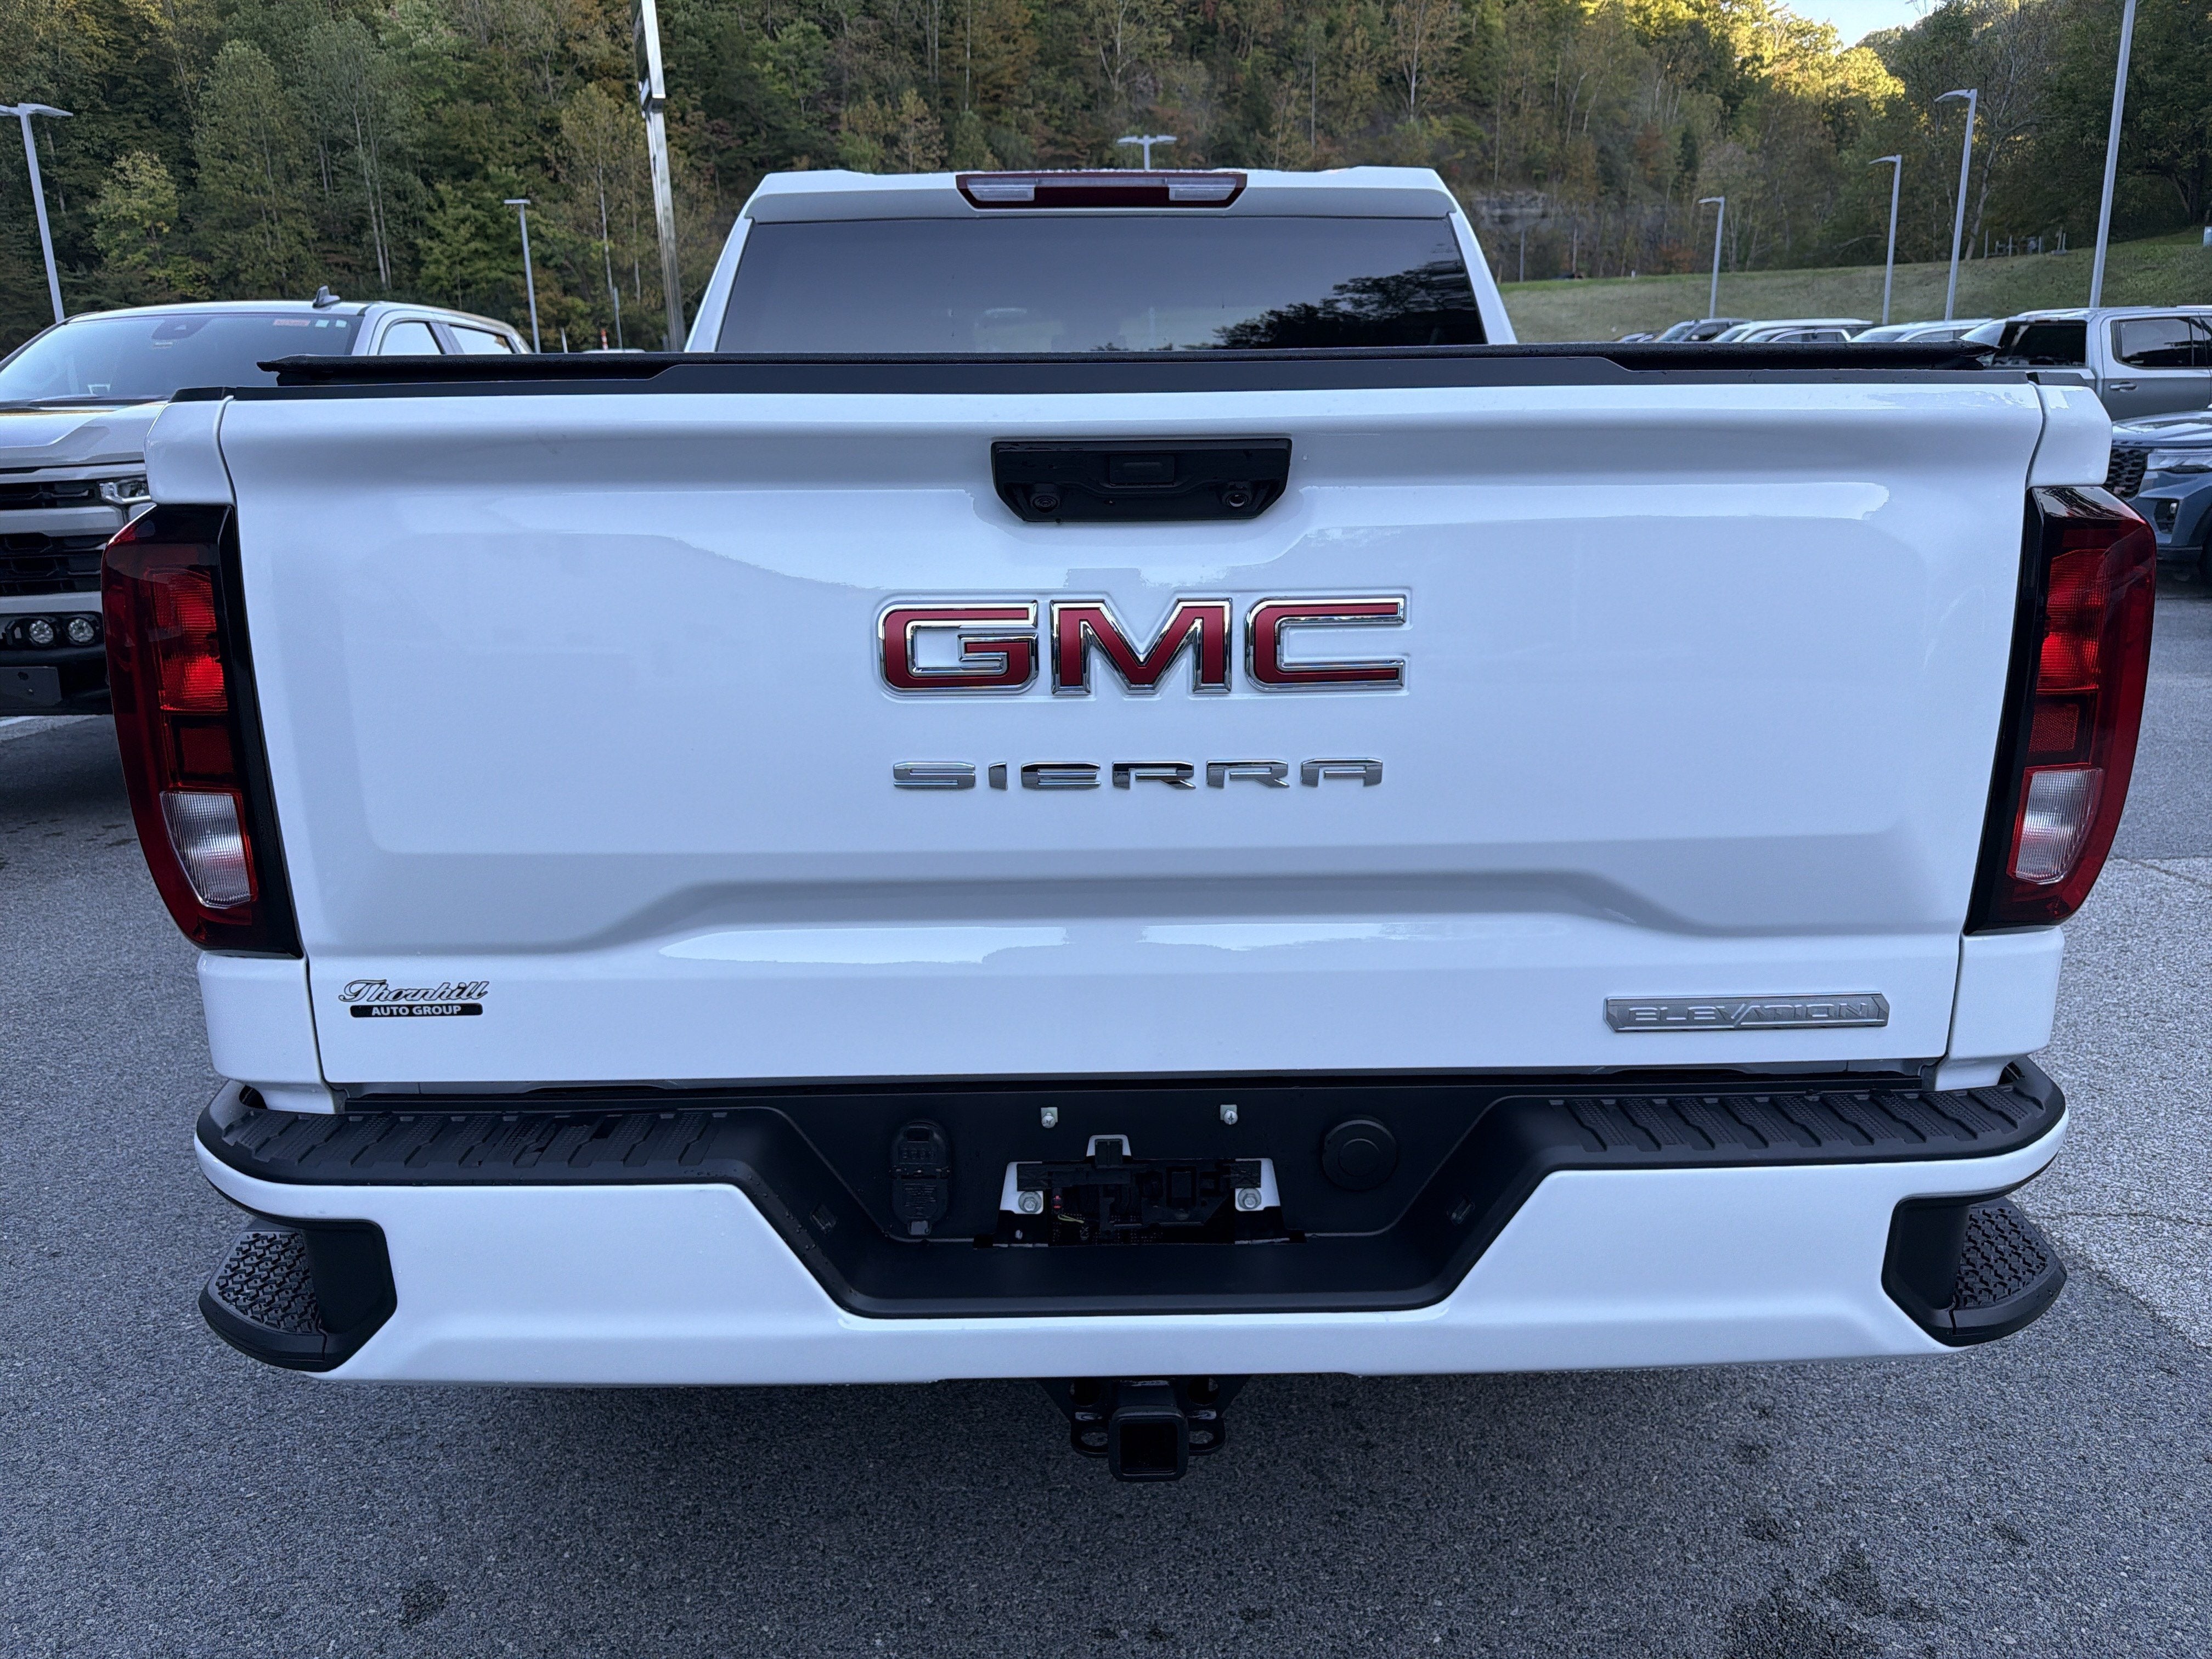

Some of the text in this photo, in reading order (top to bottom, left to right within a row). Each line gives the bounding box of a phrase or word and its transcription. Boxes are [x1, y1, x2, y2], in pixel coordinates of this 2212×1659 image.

[878, 596, 1406, 695] GMC
[893, 757, 1384, 791] SIERRA
[338, 979, 490, 1002] Thornhill
[371, 1005, 462, 1016] AUTO GROUP
[1628, 1002, 1869, 1022] ELEVATION
